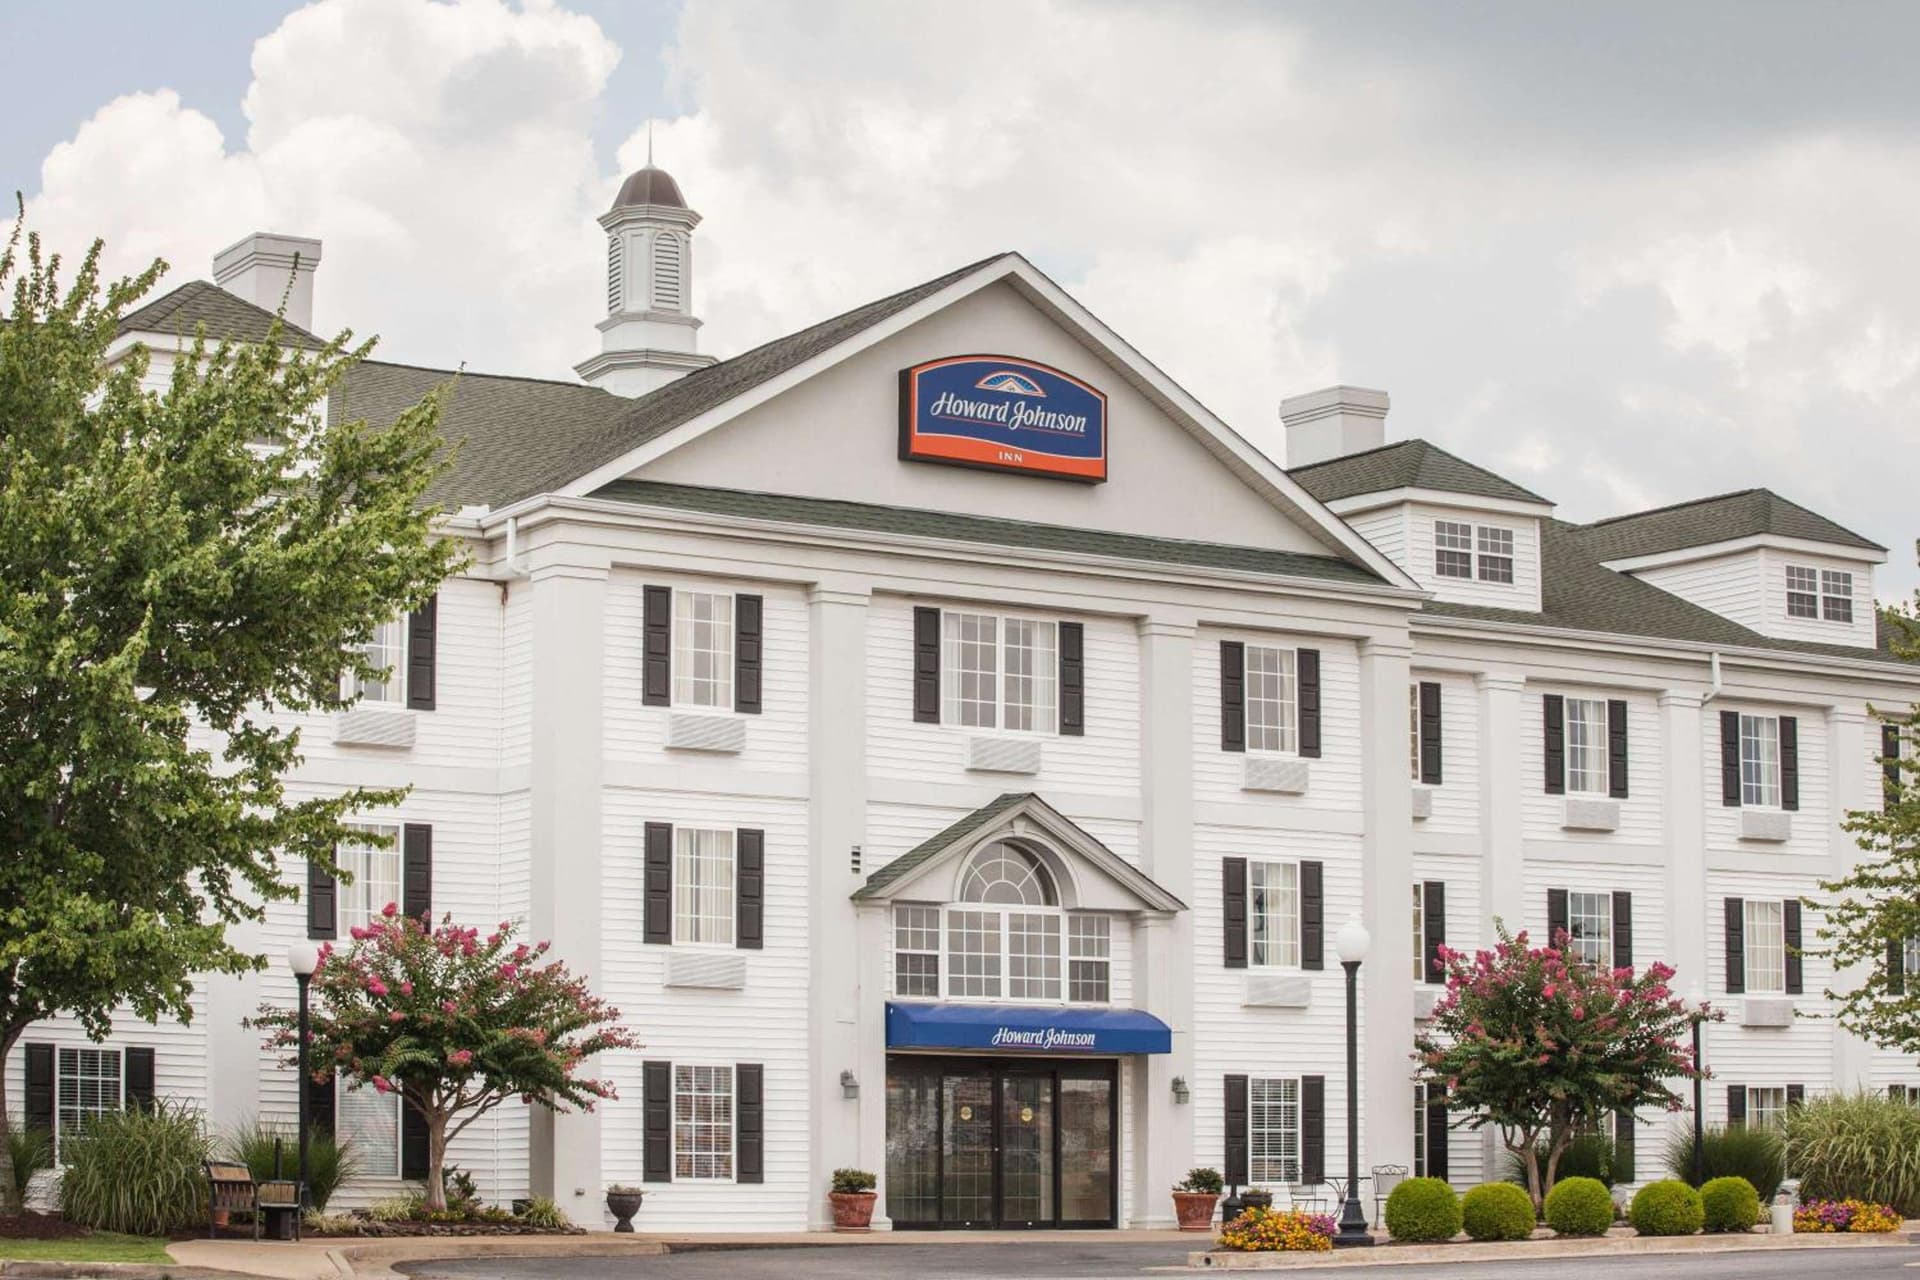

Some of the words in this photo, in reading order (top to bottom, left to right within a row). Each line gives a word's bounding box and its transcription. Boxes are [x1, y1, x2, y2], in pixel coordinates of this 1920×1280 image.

[931, 392, 1009, 422] Howard
[1008, 401, 1086, 433] Johnson
[999, 451, 1023, 462] INN
[992, 1027, 1043, 1045] Howard
[1043, 1028, 1095, 1049] Johnson
